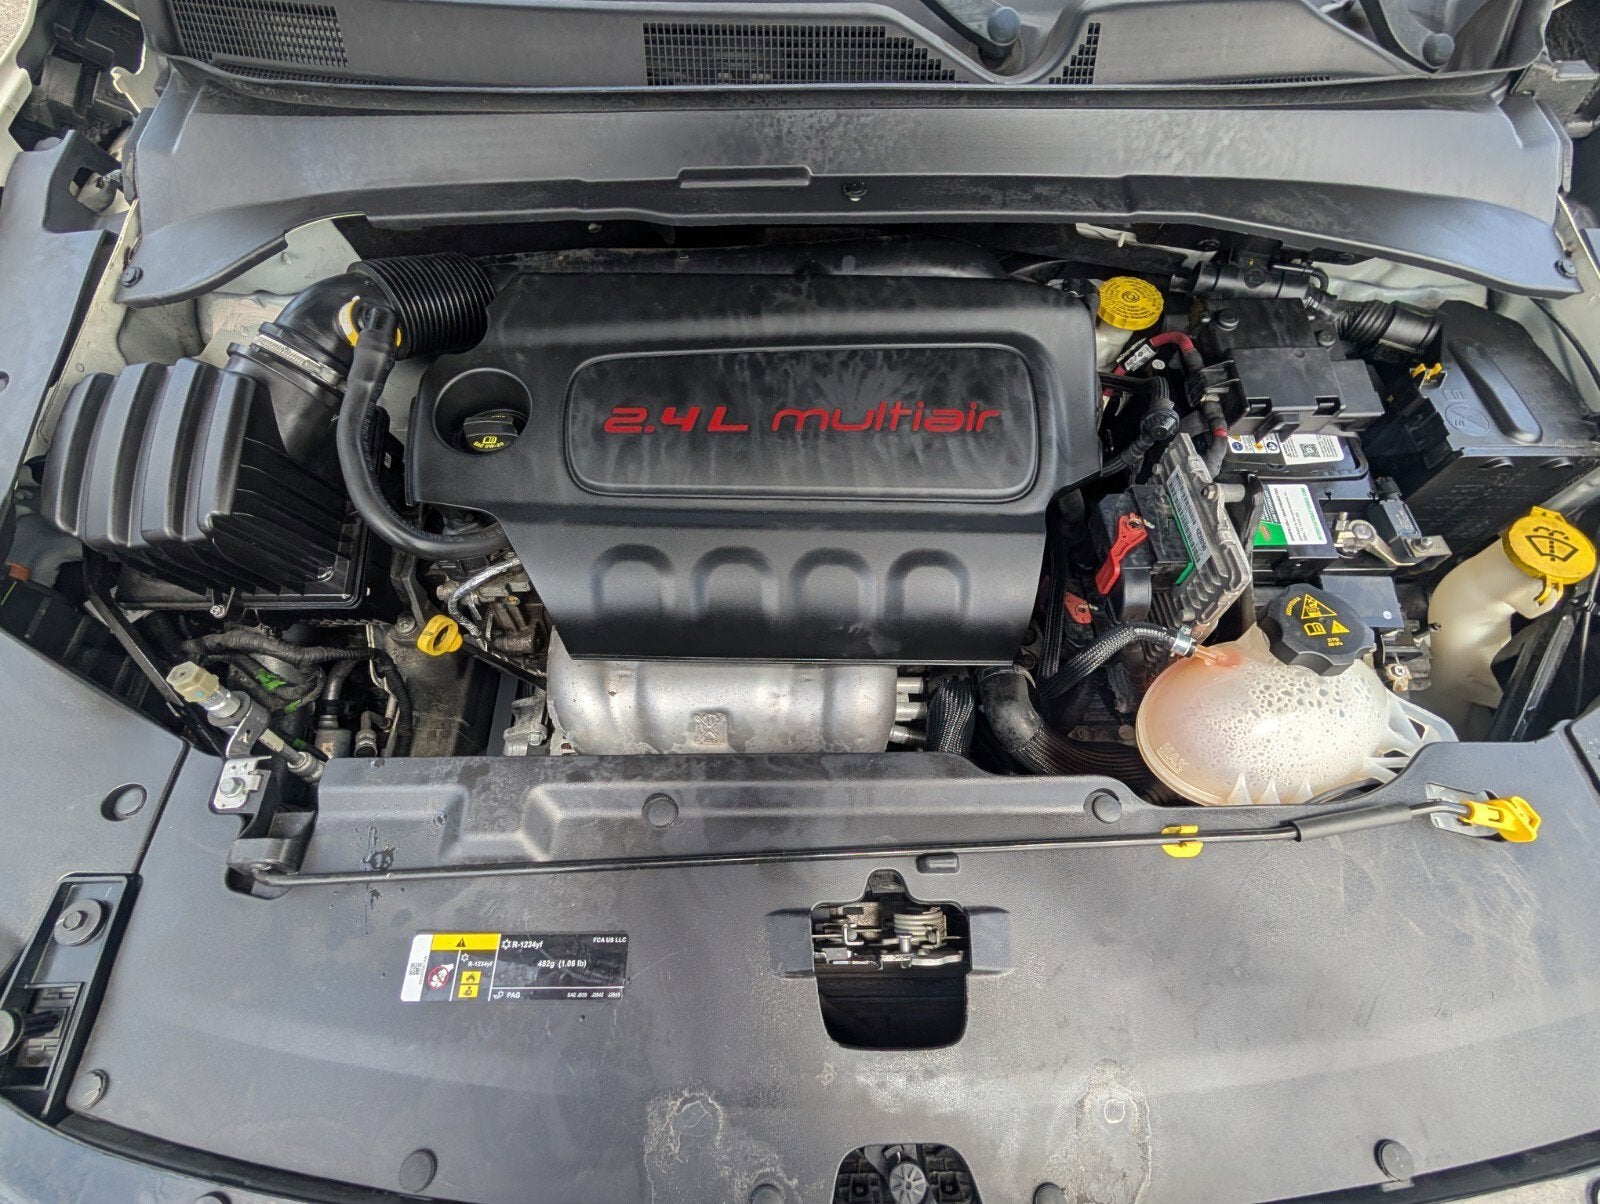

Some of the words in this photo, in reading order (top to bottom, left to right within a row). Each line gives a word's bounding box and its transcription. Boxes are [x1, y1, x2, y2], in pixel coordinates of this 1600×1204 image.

[772, 401, 999, 432] multiair
[511, 940, 544, 951] R-1234yf
[577, 960, 587, 969] lb)
